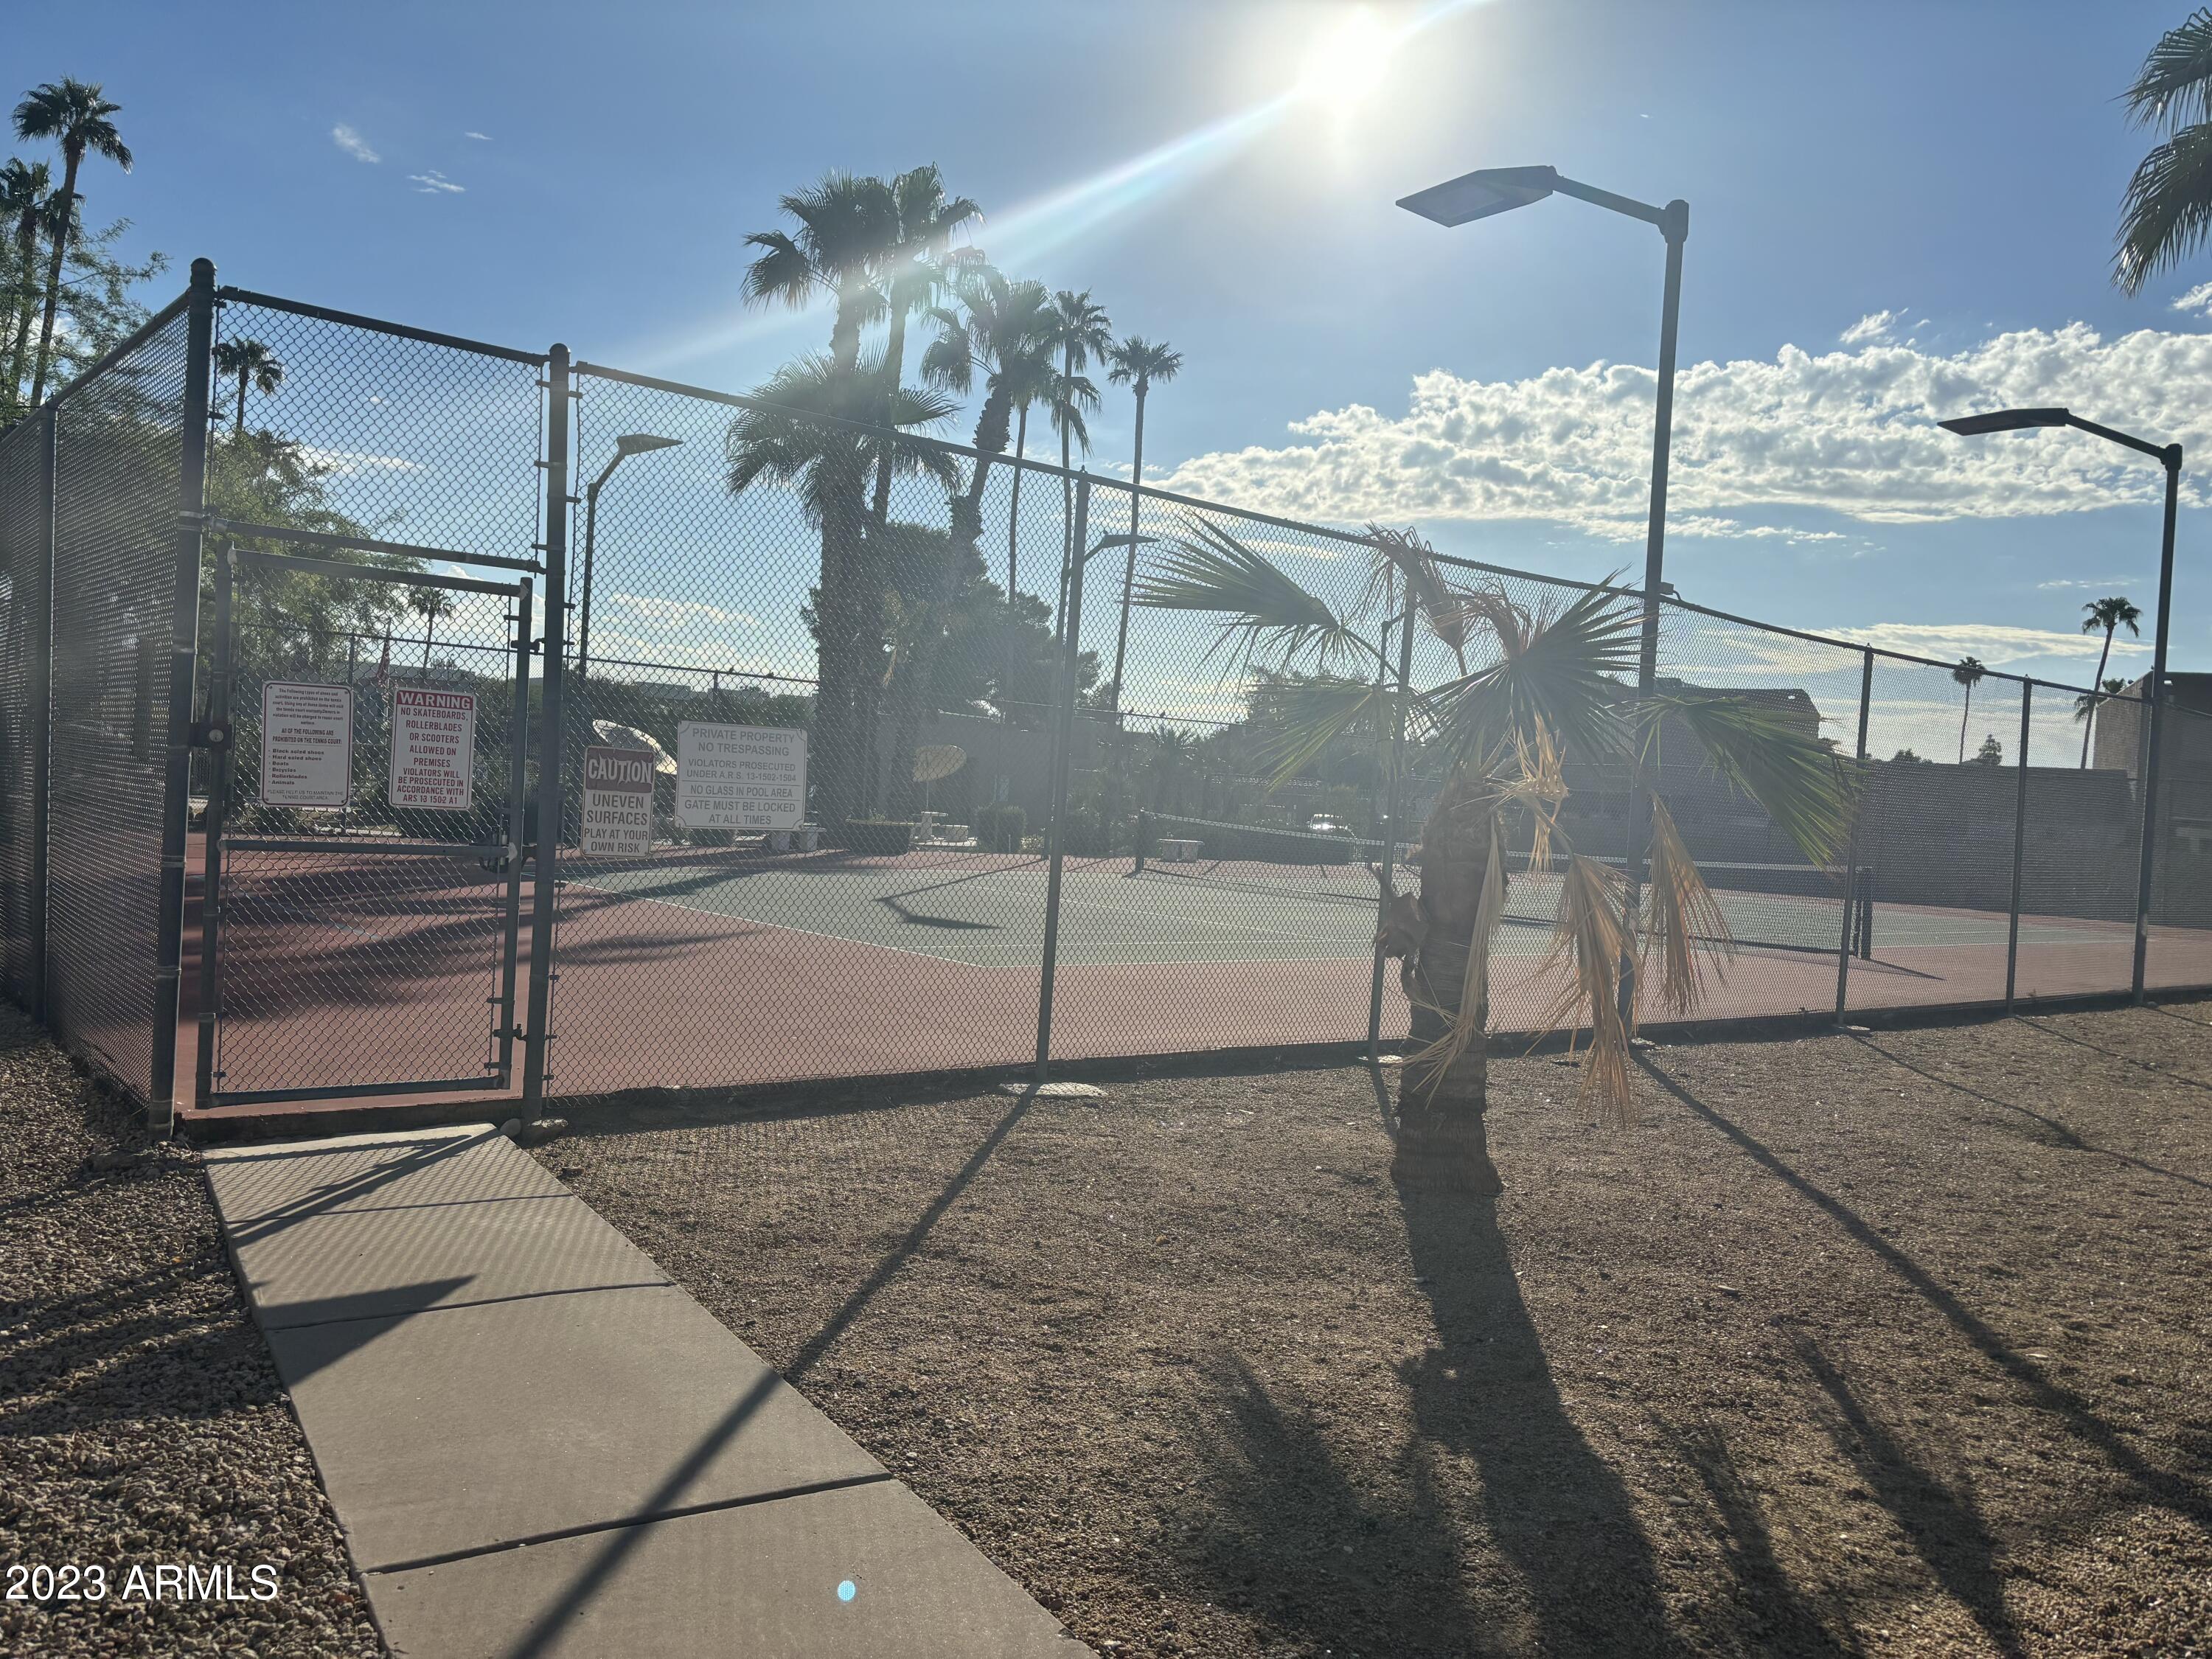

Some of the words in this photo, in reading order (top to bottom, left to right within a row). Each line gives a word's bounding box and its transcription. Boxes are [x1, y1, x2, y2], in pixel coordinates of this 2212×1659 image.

[400, 692, 470, 709] WARNING
[413, 708, 468, 720] SKATEBOARDS,
[406, 720, 462, 731] ROLLERBLADES
[422, 734, 459, 743] SCOOTERS
[692, 728, 737, 740] PRIVATE
[740, 731, 795, 742] PROPERTY
[410, 745, 444, 755] ALLOWED
[698, 742, 714, 752] NO
[717, 743, 790, 756] TRESPASSING
[414, 758, 451, 767] PREMISES
[688, 759, 737, 768] VIOLATORS
[740, 761, 796, 771] PROSECUTED
[403, 768, 442, 777] VIOLATORS
[588, 754, 653, 785] CAUTION
[409, 777, 455, 786] PROSECUTED
[686, 770, 717, 778] UNDER
[747, 772, 796, 782] 13-1502-1504
[397, 785, 443, 795] ACCORDANCE
[690, 785, 703, 794] NO
[706, 785, 734, 796] GLASS
[736, 787, 744, 796] IN
[746, 787, 768, 796] POOL
[771, 789, 793, 797] AREA
[593, 793, 644, 809] UNEVEN
[685, 800, 711, 810] GATE
[713, 801, 740, 810] MUST
[742, 802, 755, 811] BE
[758, 802, 796, 812] LOCKED
[586, 810, 648, 825] SURFACES
[709, 814, 721, 823] AT
[723, 814, 741, 824] ALL
[744, 815, 771, 824] TIMES
[584, 828, 607, 838] PLAY
[609, 830, 620, 838] AT
[624, 830, 648, 840] YOUR
[591, 841, 614, 852] OWN
[618, 843, 640, 852] RISK
